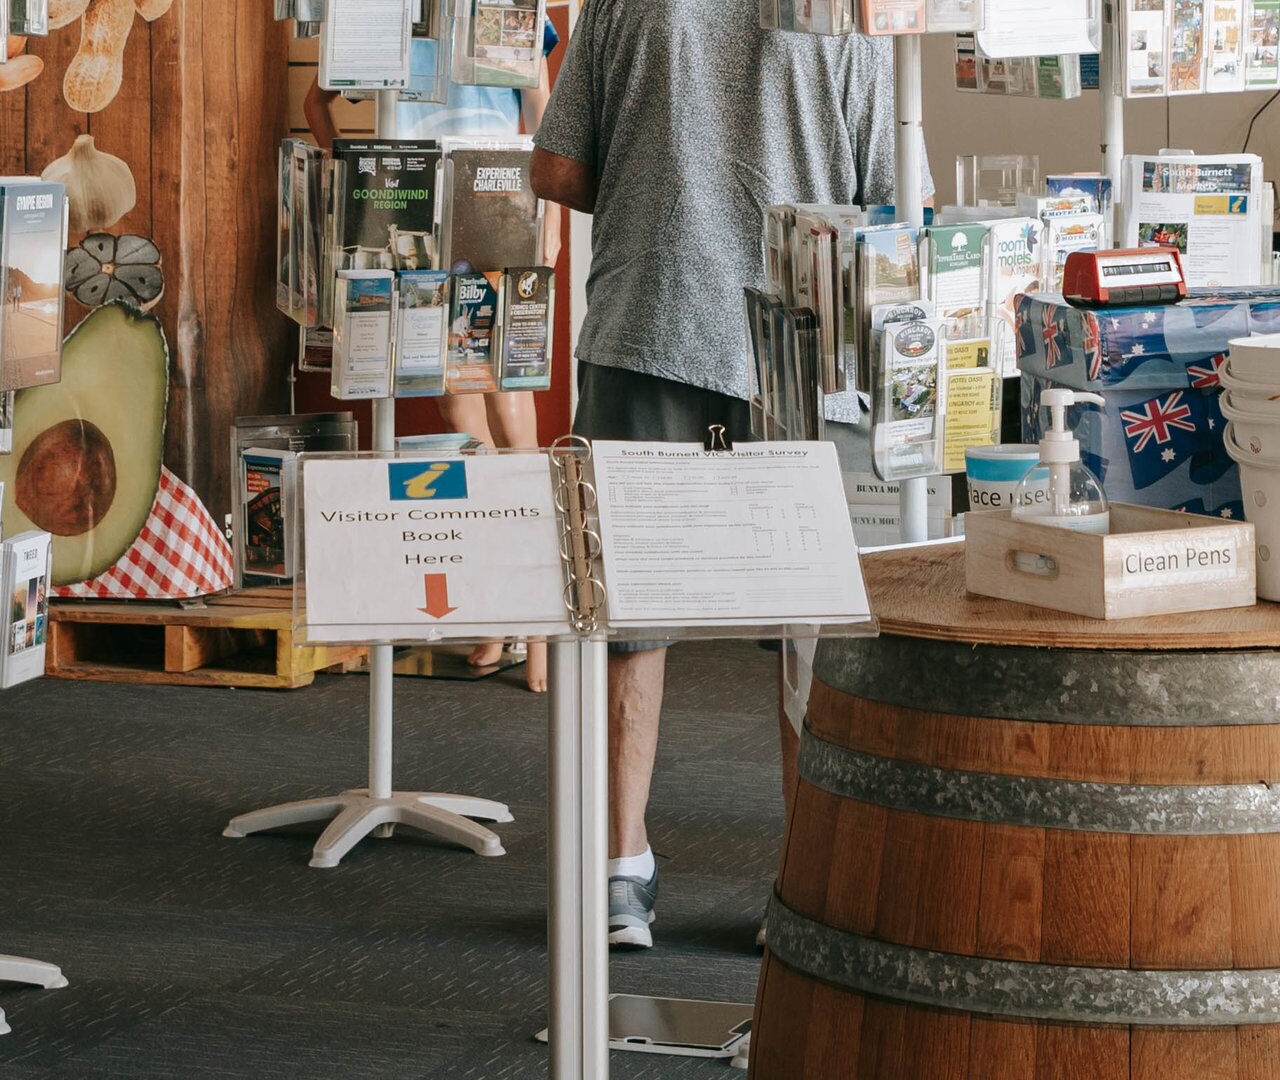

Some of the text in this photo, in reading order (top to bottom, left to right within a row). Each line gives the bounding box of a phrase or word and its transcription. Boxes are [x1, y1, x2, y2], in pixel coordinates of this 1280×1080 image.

[476, 167, 522, 180] EXPERIENCE
[1162, 167, 1233, 177] South Burnett
[473, 179, 522, 192] CHARLEVILLE
[352, 189, 429, 200] GOONDIWINDI
[373, 200, 408, 209] REGION
[1104, 268, 1117, 276] FRI
[460, 284, 487, 301] Bilby
[620, 449, 654, 457] South
[768, 449, 810, 457] Survey
[856, 484, 885, 493] BUNYA
[321, 506, 540, 522] Visitor Comments
[401, 529, 464, 542] Book
[404, 551, 464, 565] Here
[1125, 547, 1232, 574] Clean Pens
